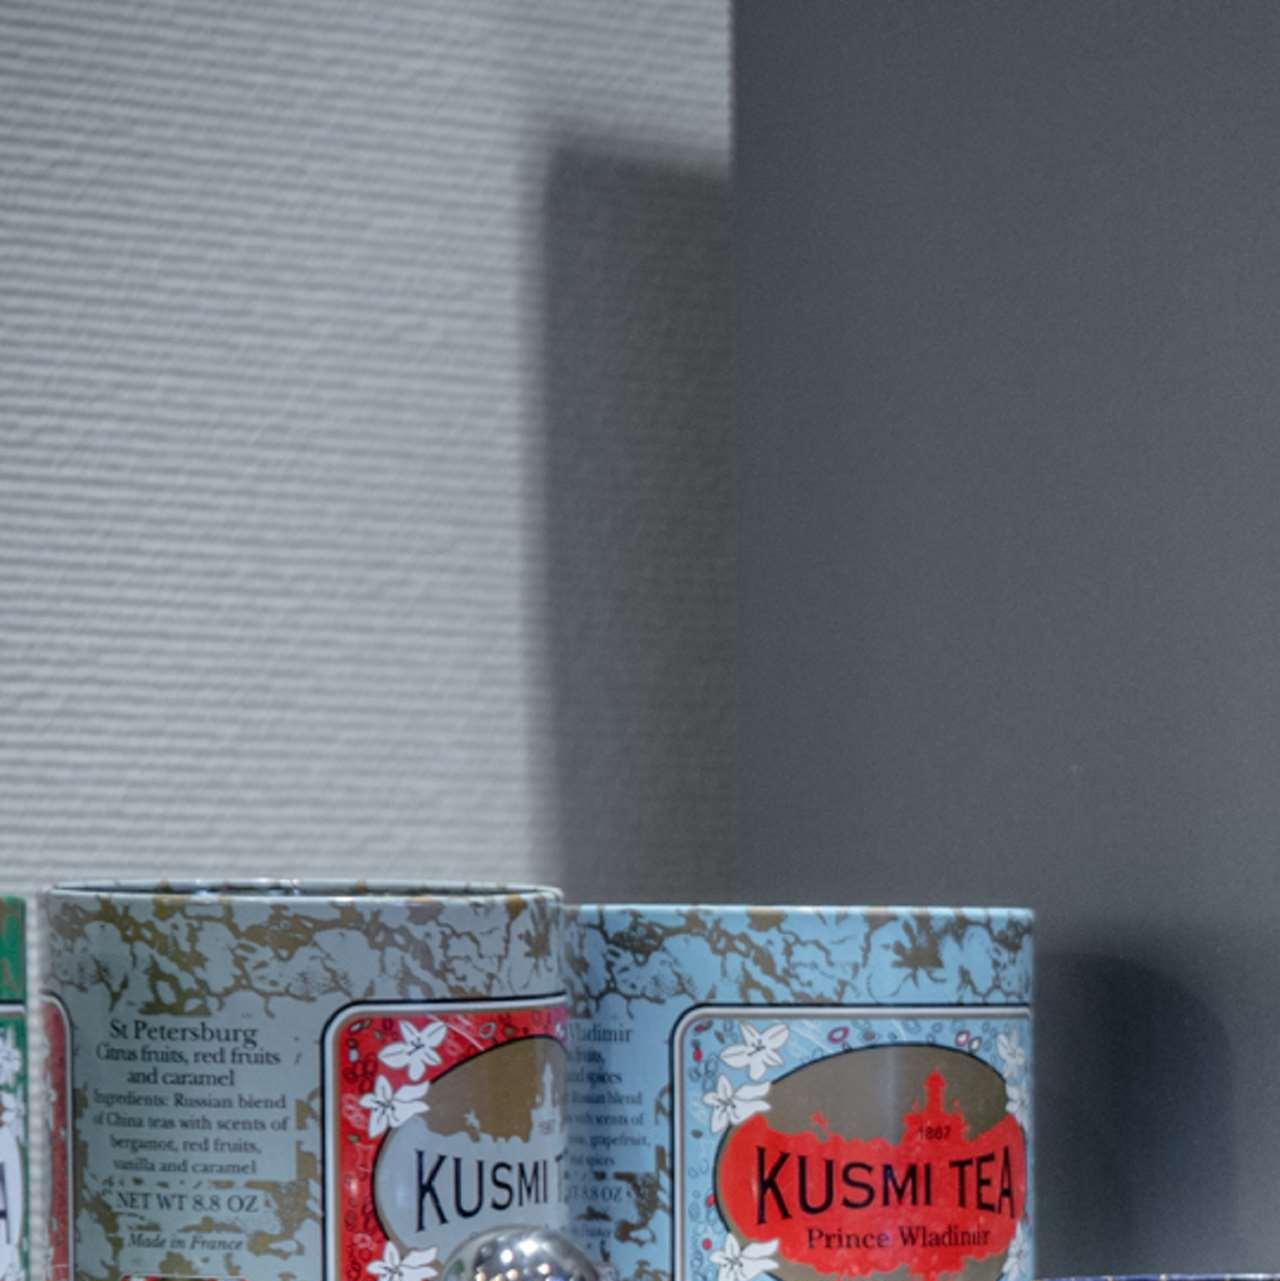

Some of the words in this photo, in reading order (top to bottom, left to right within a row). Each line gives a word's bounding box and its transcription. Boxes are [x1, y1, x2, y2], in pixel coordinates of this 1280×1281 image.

[109, 1018, 128, 1040] St
[133, 1018, 260, 1049] Petersburg
[141, 1043, 189, 1066] fruits,
[193, 1046, 226, 1064] red
[230, 1047, 282, 1066] fruits
[126, 1066, 159, 1085] and
[162, 1068, 236, 1087] caramel
[173, 1091, 233, 1109] Russian
[237, 1093, 287, 1110] blend
[178, 1114, 213, 1130] with
[216, 1117, 267, 1131] scents
[270, 1115, 291, 1132] of
[182, 1137, 210, 1151] red
[213, 1137, 263, 1154] fruits,
[158, 1159, 189, 1174] and
[191, 1160, 257, 1175] caramel
[414, 1148, 549, 1233] KUSMI
[755, 1146, 932, 1225] KUSMI
[949, 1145, 1017, 1219] TEA
[156, 1193, 189, 1212] WT
[191, 1194, 222, 1213] 8.8
[226, 1194, 260, 1214] OZ
[127, 1232, 166, 1250] Made
[169, 1233, 186, 1250] in
[189, 1234, 244, 1251] France
[806, 1226, 891, 1250] Prince
[899, 1225, 992, 1249] Wladimir
